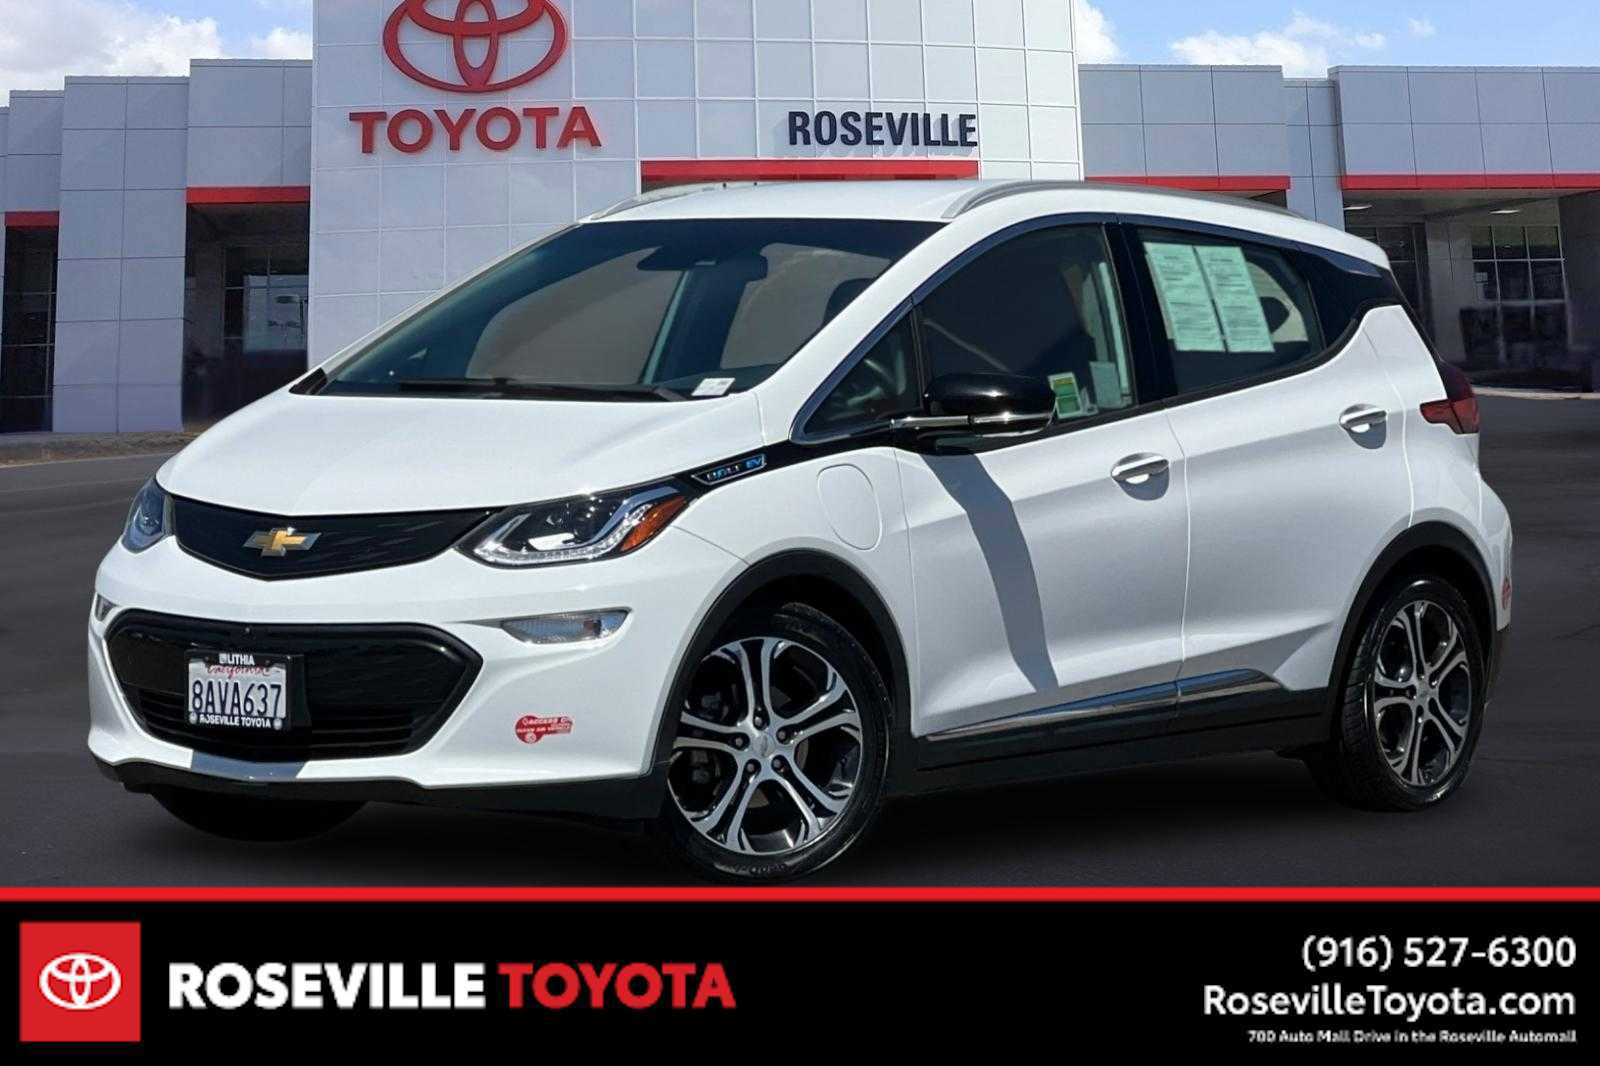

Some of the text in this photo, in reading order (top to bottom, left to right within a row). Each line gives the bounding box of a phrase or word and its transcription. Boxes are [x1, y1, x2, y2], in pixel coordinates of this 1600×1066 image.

[349, 106, 603, 154] TOYOTA
[788, 111, 978, 147] ROSEVILLE
[227, 653, 255, 665] LITHIA
[191, 679, 282, 718] 8AVA637
